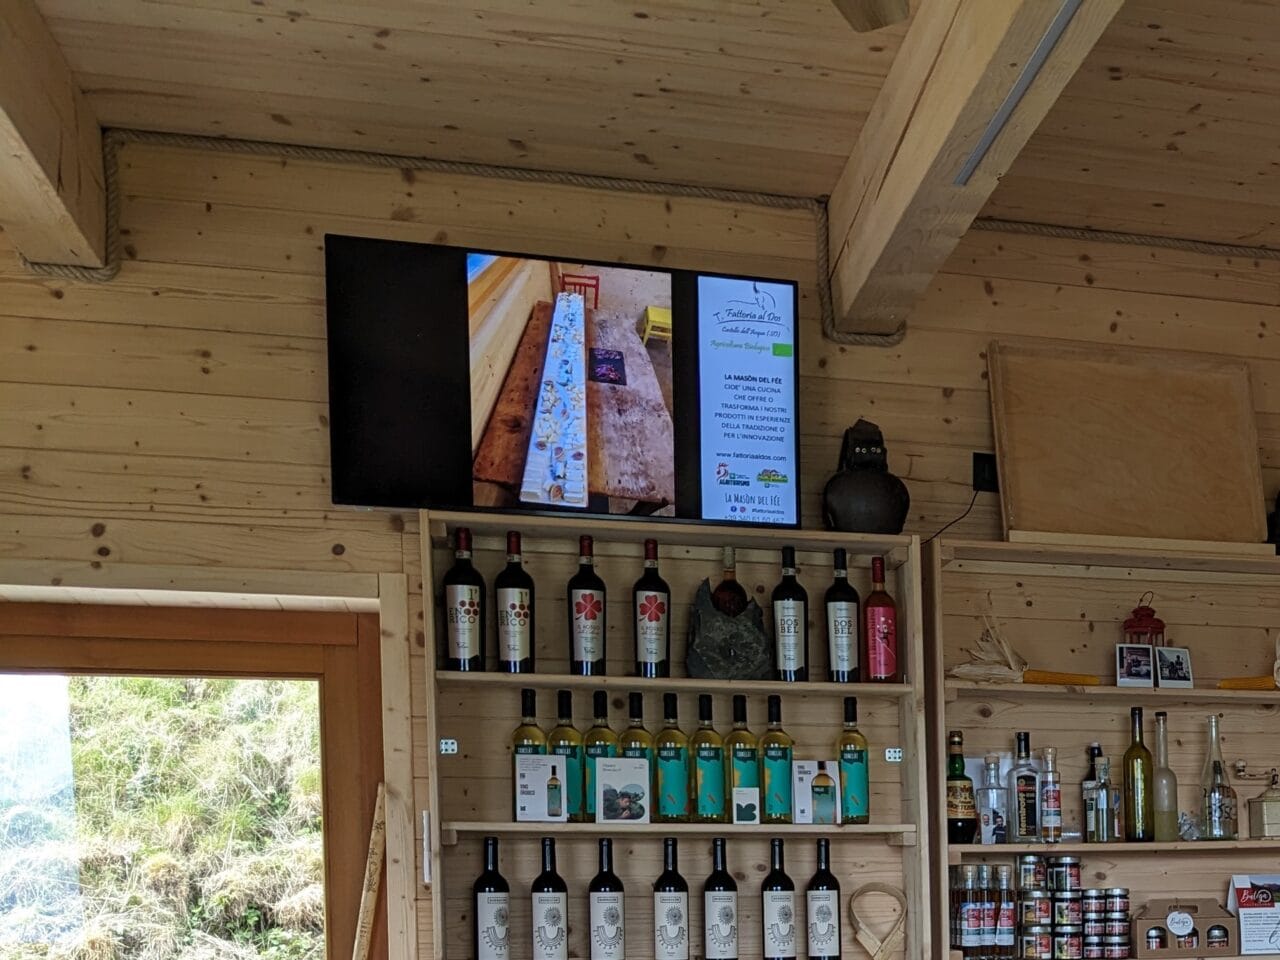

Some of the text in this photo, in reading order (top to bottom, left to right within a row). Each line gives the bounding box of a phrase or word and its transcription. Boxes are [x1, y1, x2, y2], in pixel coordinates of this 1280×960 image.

[725, 308, 757, 319] Fattoria
[758, 310, 767, 320] al
[767, 312, 781, 321] Dos
[721, 403, 759, 411] TRASFORMA
[714, 412, 746, 420] PRODOTTI
[756, 415, 791, 423] ESPERIENZE
[742, 424, 777, 432] TRADIZIONE
[737, 434, 784, 442] L'INNOVAZIONE
[725, 493, 732, 502] LA
[758, 496, 768, 506] DEL
[780, 618, 798, 627] DOS
